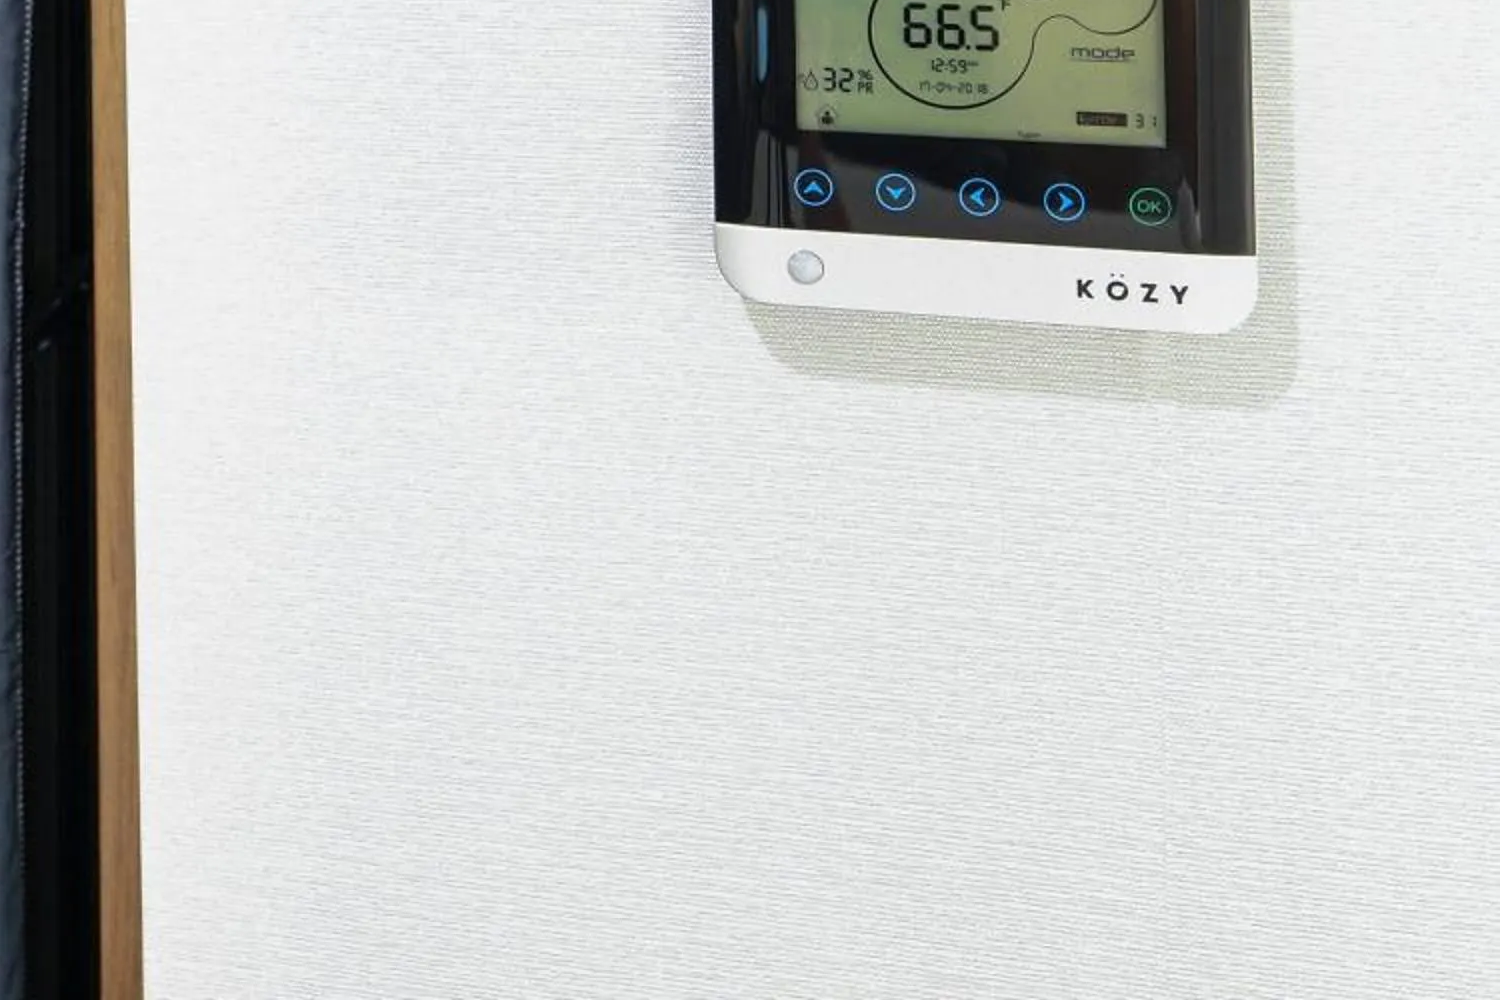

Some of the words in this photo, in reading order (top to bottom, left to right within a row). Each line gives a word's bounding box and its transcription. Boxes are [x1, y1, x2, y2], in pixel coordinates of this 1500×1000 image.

[903, 2, 999, 52] 66.5
[1070, 45, 1136, 60] mode
[823, 67, 854, 93] 32
[1137, 199, 1162, 214] OK
[1076, 272, 1189, 305] KÖZY
